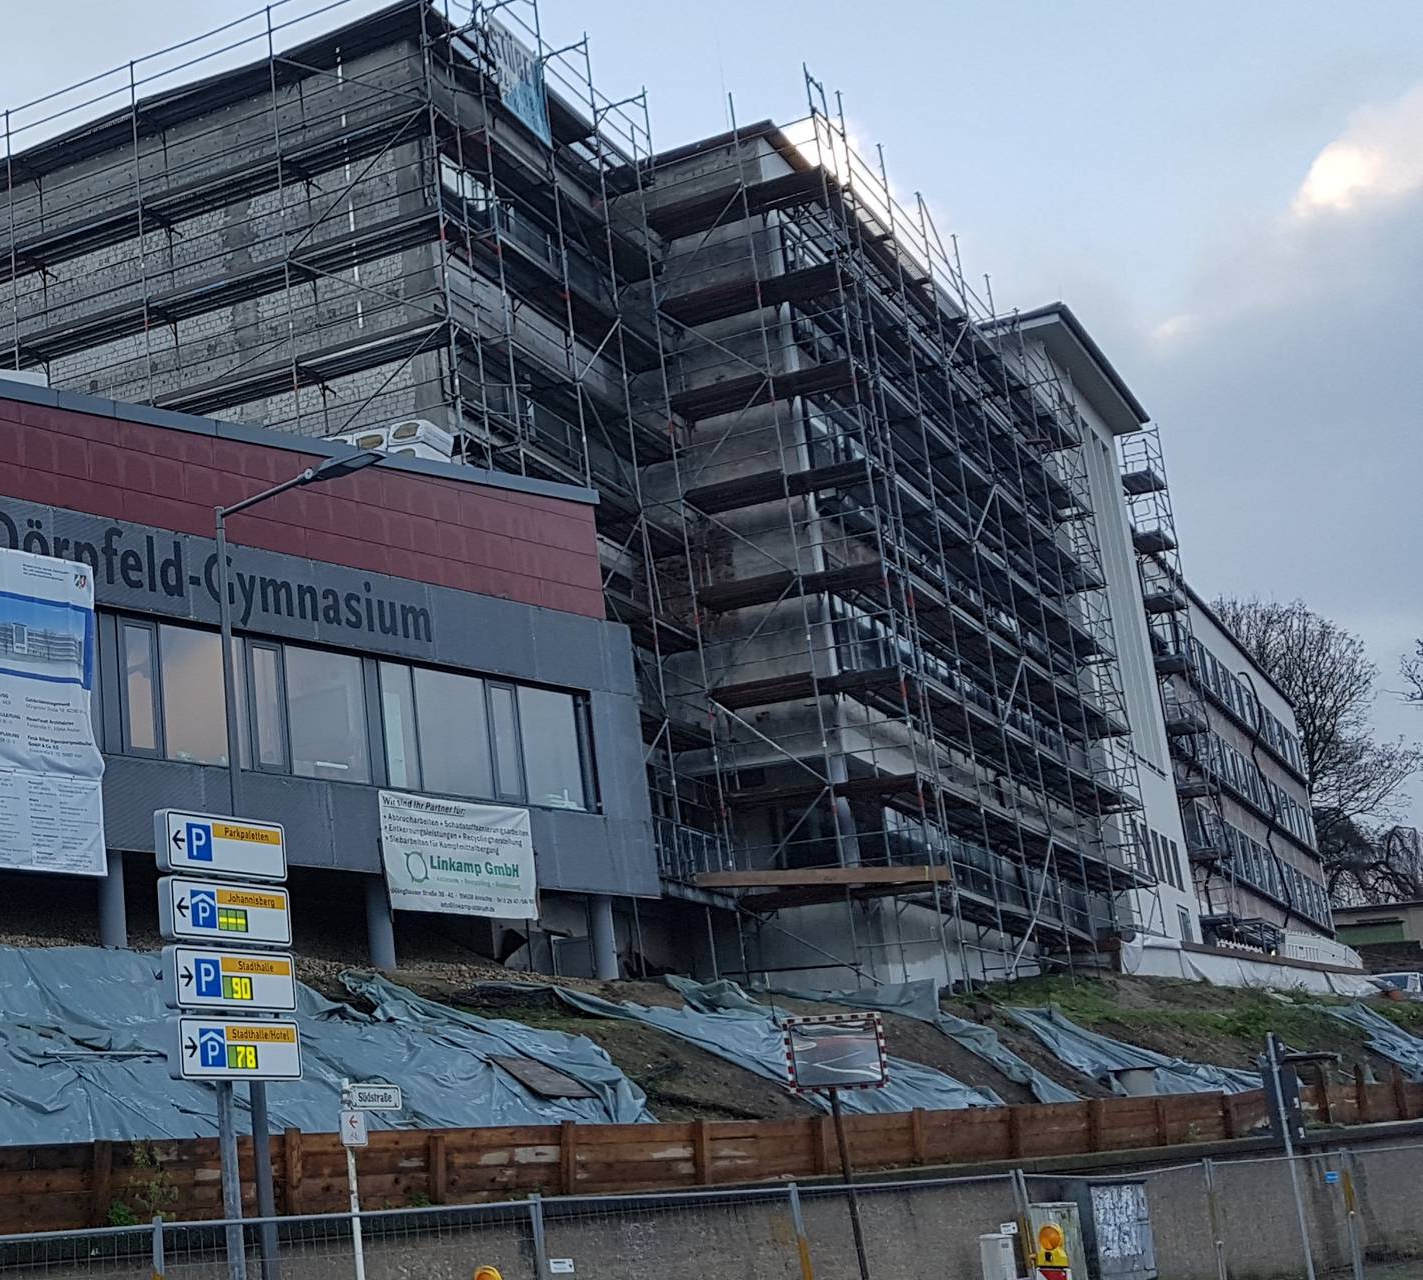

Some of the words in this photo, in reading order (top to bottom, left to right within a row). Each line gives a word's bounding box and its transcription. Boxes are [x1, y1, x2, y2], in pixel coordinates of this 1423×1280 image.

[413, 800, 424, 809] Ihr
[425, 802, 452, 813] Partner
[191, 828, 206, 856] P
[224, 827, 269, 842] Parkpaletten
[429, 855, 482, 877] Linkamp
[484, 861, 520, 878] GmbH
[227, 893, 276, 909] Johannisberg
[198, 902, 210, 926] P
[200, 963, 215, 992] P
[238, 960, 274, 973] Stadthalle
[231, 977, 252, 999] 90
[232, 1028, 290, 1041] Stadthalle/Hotel
[209, 1040, 220, 1065] P
[236, 1045, 257, 1068] 78
[358, 1091, 393, 1103] Südstraße
